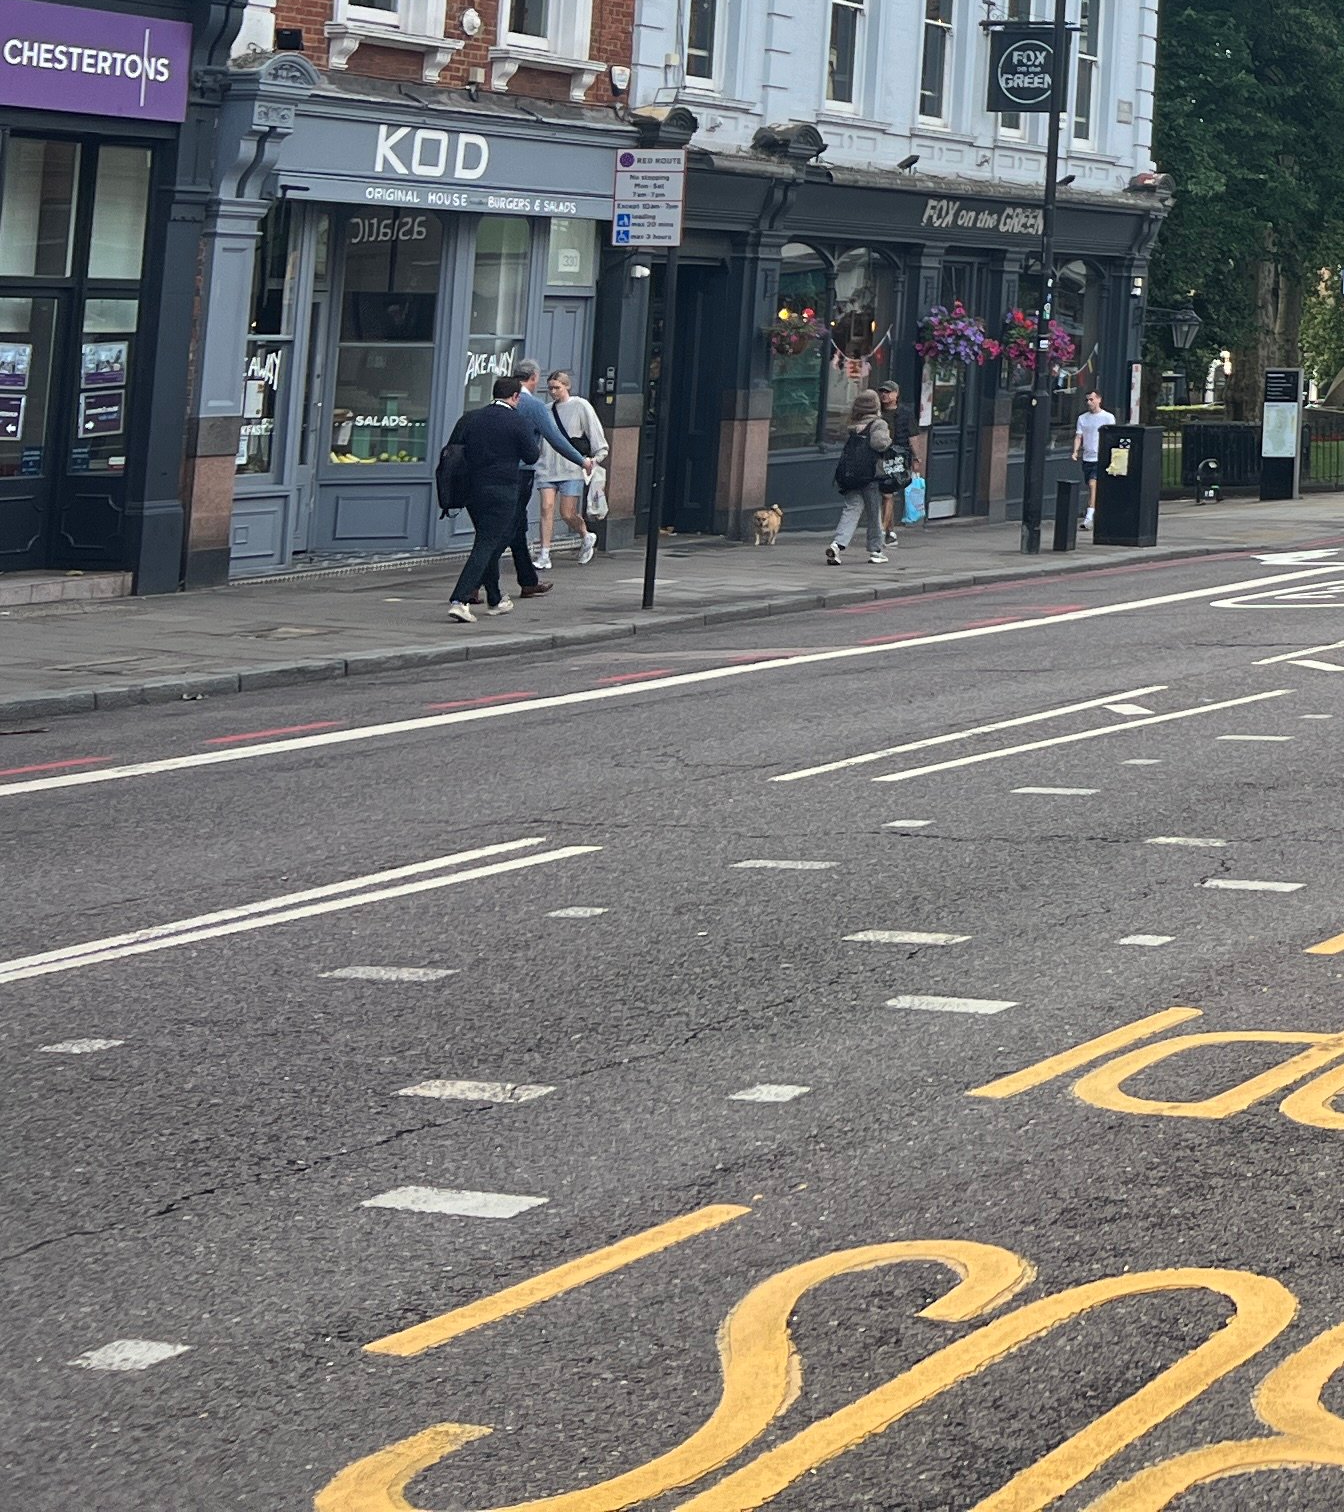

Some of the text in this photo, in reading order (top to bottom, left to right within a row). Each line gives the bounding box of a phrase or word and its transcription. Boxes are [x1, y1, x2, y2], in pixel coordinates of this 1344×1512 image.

[3, 38, 170, 83] CHESTERTONS
[1012, 50, 1047, 65] FOX
[1001, 73, 1052, 89] GREEN
[374, 124, 490, 180] KOD
[655, 157, 681, 165] ROUTE
[366, 187, 420, 204] ORIGINAL
[427, 192, 468, 206] HOUSE
[487, 196, 531, 211] BURGERS
[543, 199, 577, 214] SALADS
[921, 199, 1044, 235] FOX on the GREEN
